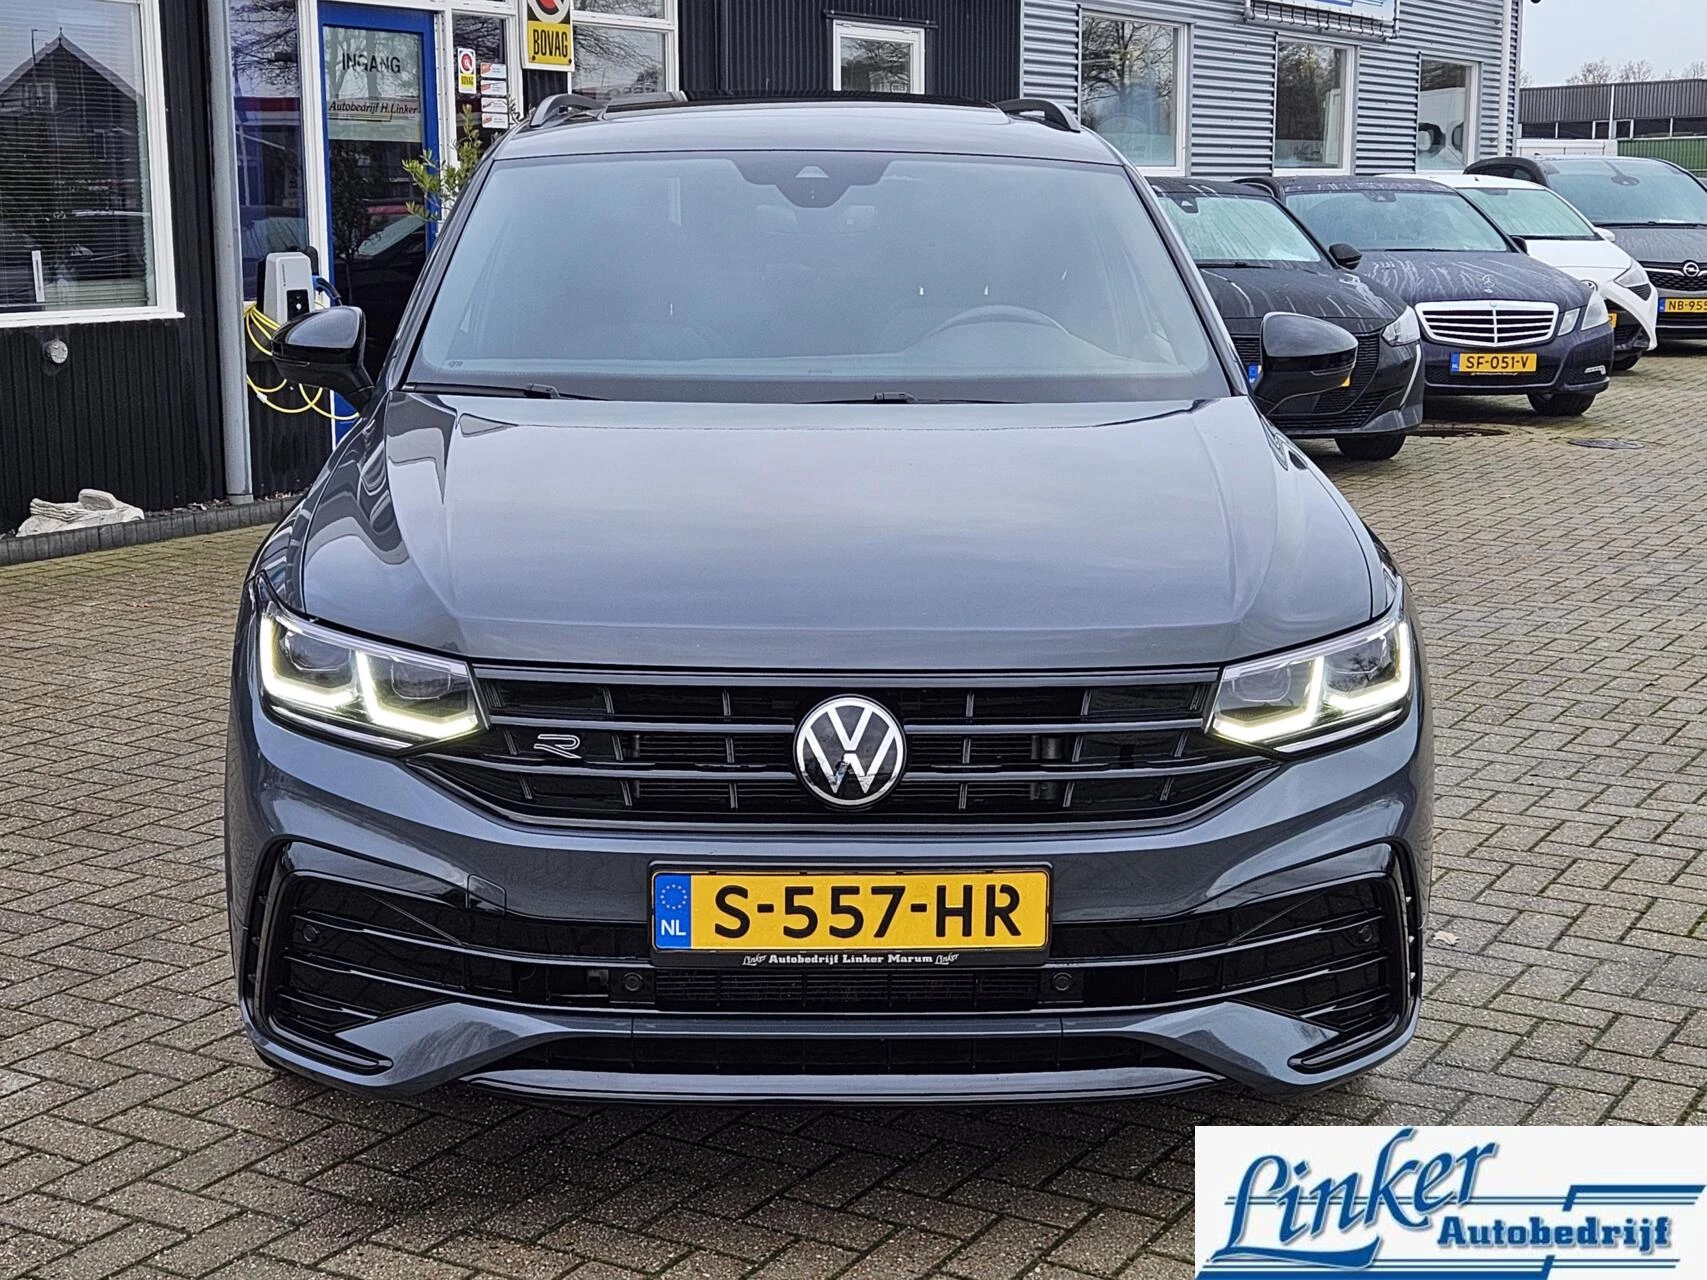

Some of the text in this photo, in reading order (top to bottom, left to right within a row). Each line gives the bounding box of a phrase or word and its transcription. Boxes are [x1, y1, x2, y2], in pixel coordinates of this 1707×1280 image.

[532, 29, 568, 58] BOVAG
[342, 52, 401, 74] INGANG
[328, 100, 378, 114] Autobedrijf
[1465, 355, 1529, 369] SF-051-V
[660, 883, 1022, 939] NL S-557-HR
[768, 954, 839, 965] Autobedrijf
[842, 954, 884, 964] Linker
[887, 954, 933, 964] Marum
